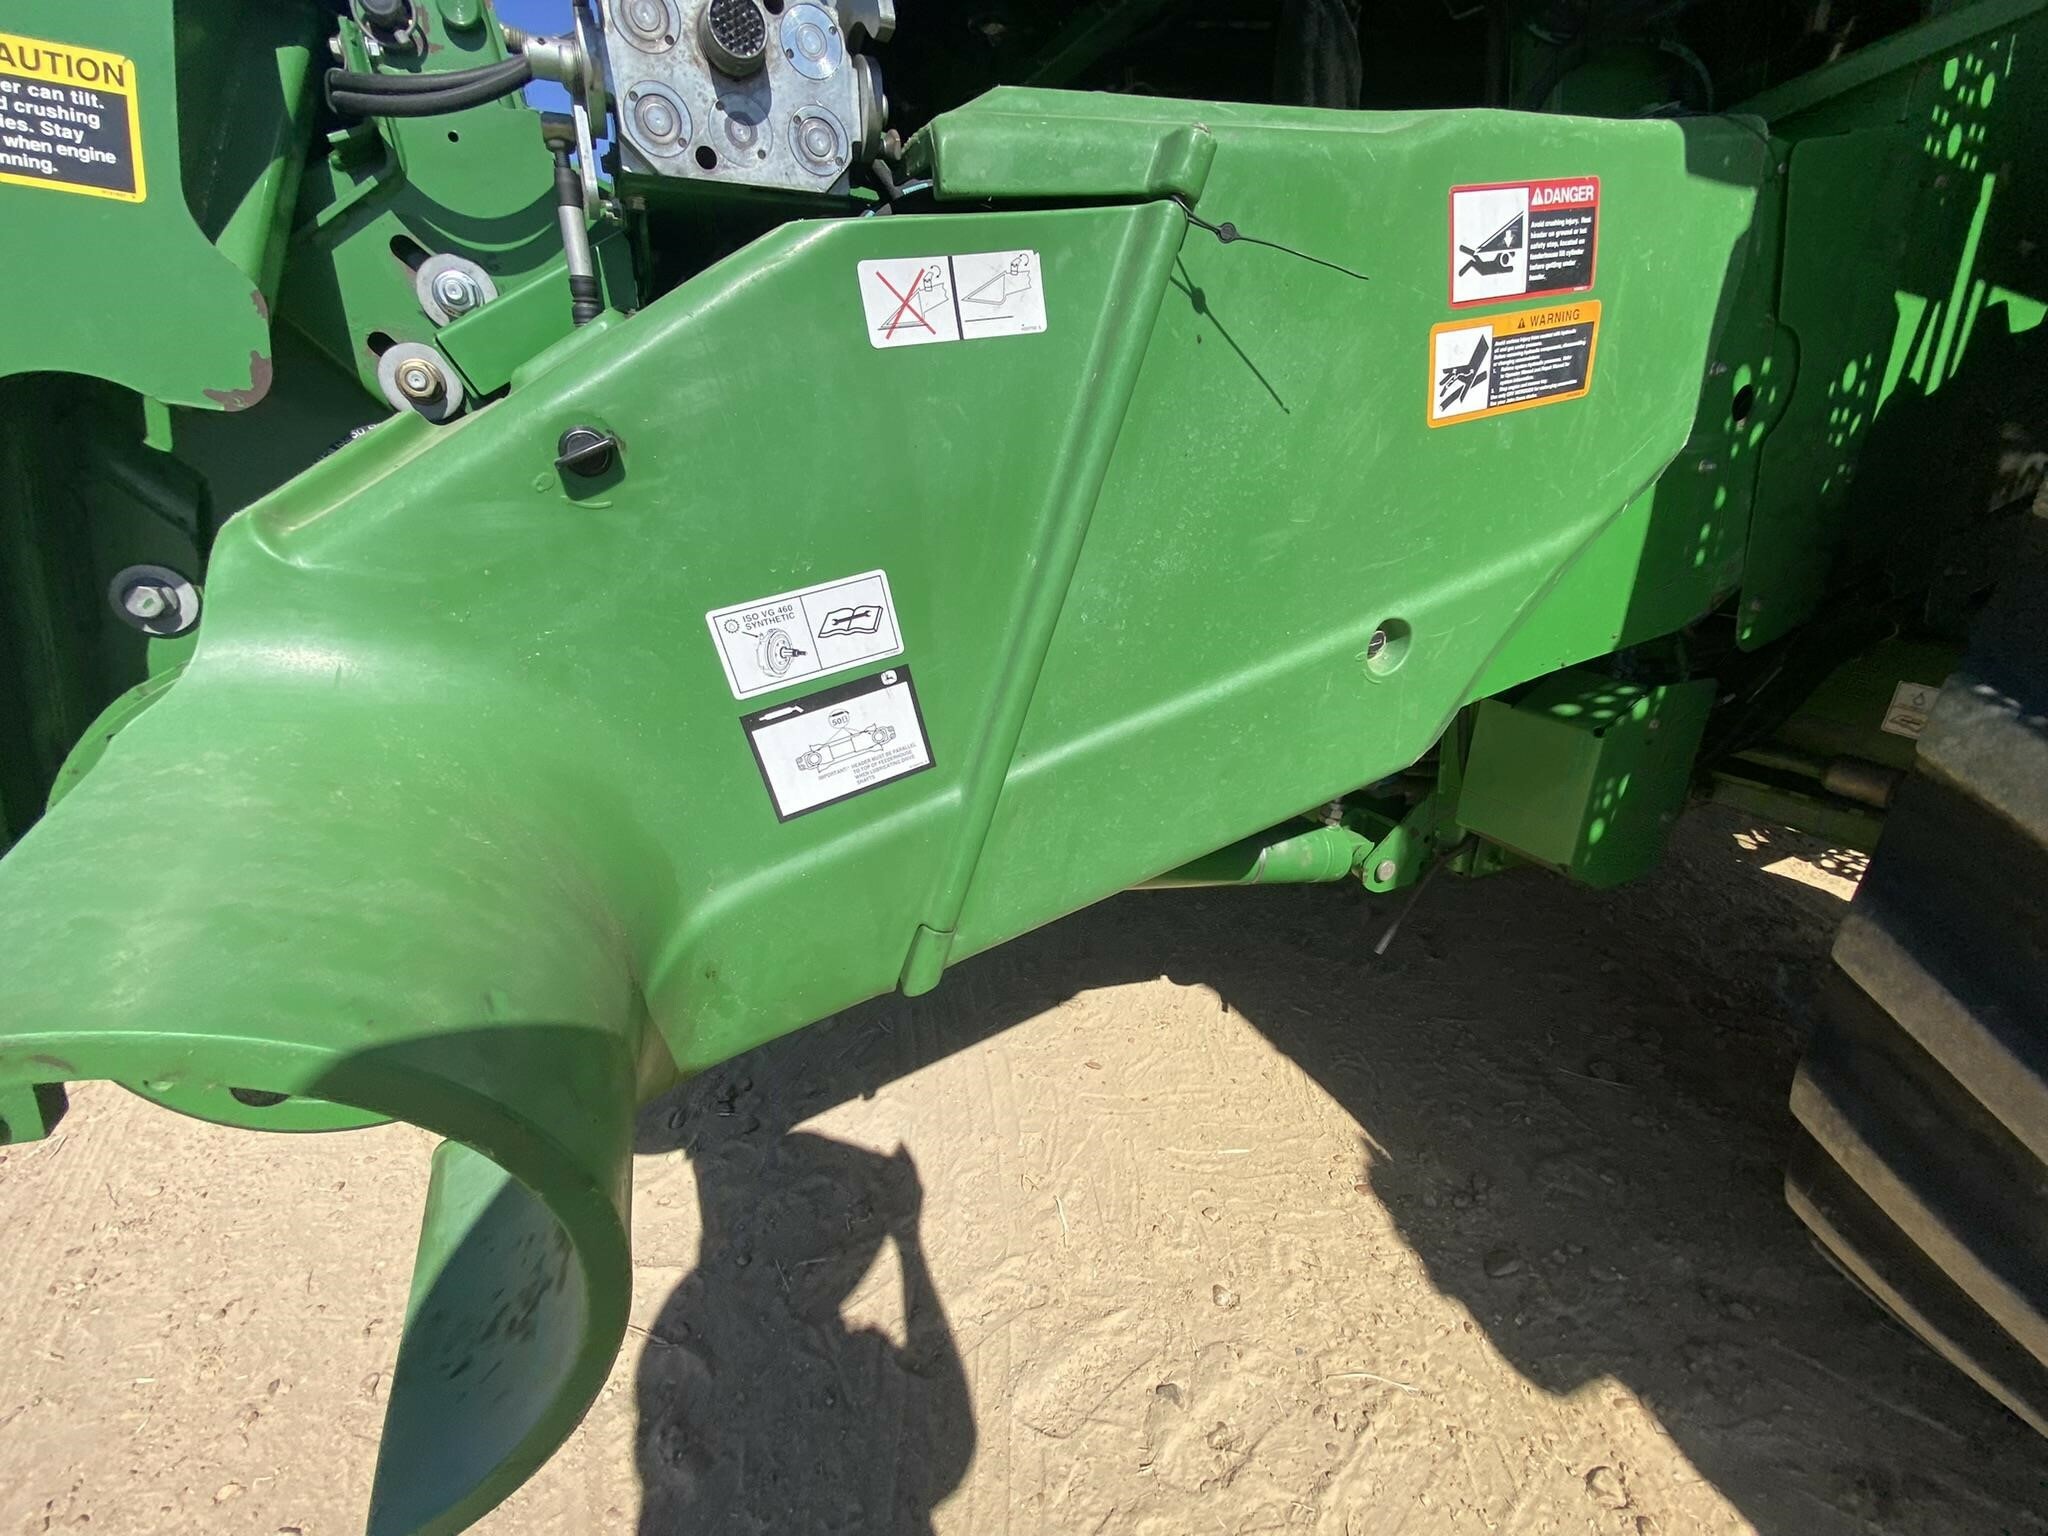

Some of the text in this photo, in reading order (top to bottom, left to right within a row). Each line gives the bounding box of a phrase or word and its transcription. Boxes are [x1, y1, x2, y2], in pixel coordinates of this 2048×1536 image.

[27, 85, 64, 102] can
[70, 89, 105, 109] tilt.
[13, 101, 100, 129] crushing
[40, 120, 84, 144] Stay
[3, 134, 117, 164] when engine
[1544, 185, 1594, 204] DANGER
[1530, 309, 1580, 327] WARNING
[742, 604, 793, 623] ISO VG 460
[745, 611, 795, 631] SYNTHETIC
